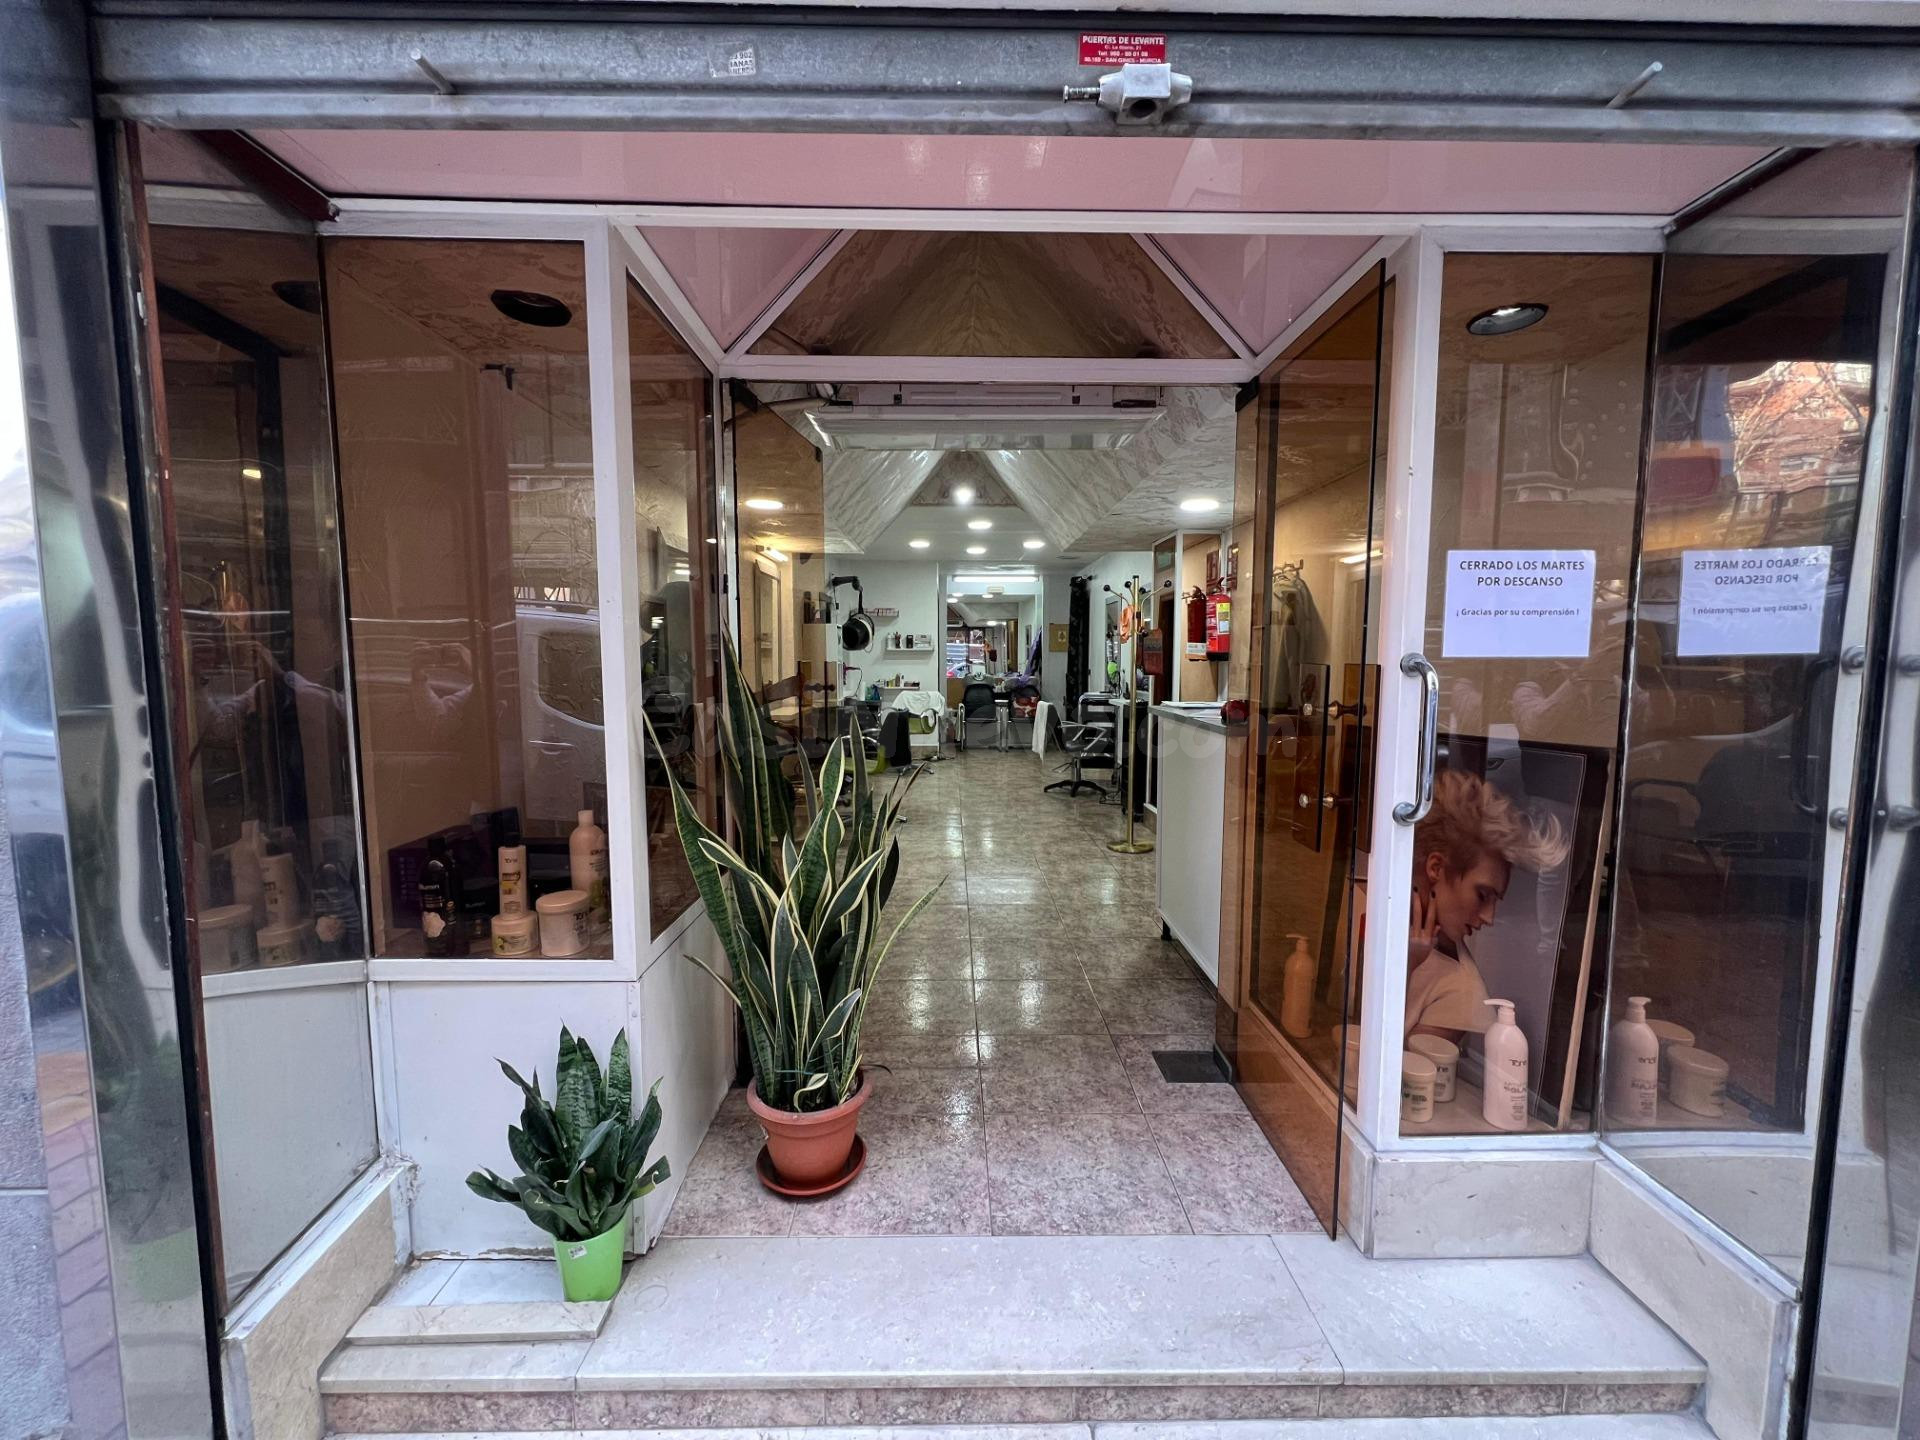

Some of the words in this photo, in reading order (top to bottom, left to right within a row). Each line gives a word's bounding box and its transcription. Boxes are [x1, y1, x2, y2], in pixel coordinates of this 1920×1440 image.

[1082, 35, 1117, 44] PUERTAS
[1118, 36, 1129, 44] DE
[1131, 37, 1165, 45] LEVANTE
[1460, 560, 1514, 570] CERRADO
[1516, 560, 1538, 570] LOS
[1541, 561, 1585, 570] MARTES
[1477, 576, 1501, 586] POR
[1504, 577, 1563, 587] DESCANSO
[1461, 608, 1492, 616] Gracias
[1521, 608, 1575, 617] comprensión
